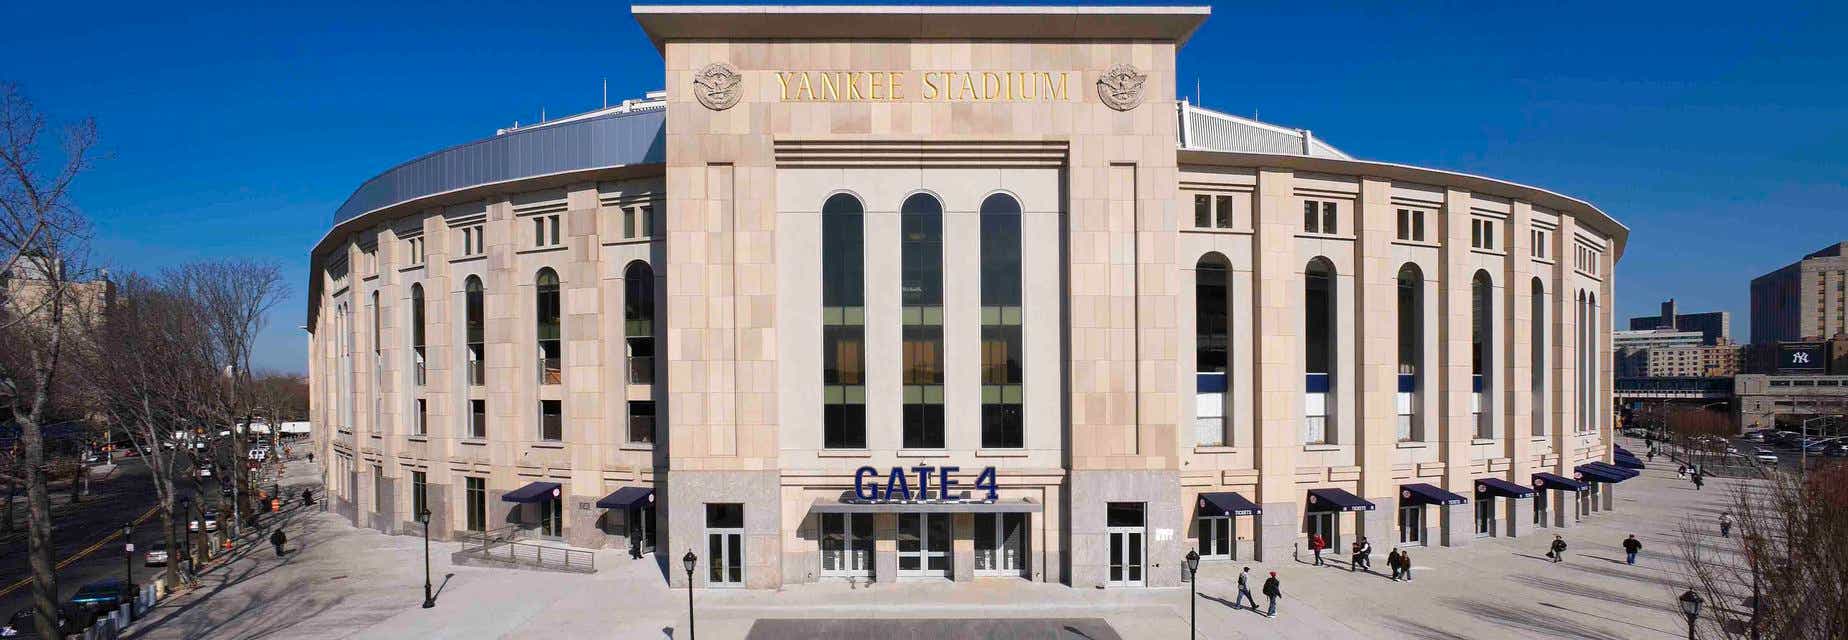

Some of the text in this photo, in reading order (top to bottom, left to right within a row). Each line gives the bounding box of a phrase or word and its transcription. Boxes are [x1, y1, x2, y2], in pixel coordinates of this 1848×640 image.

[776, 71, 1069, 101] YANKEE STADIUM
[854, 466, 999, 500] GATE 4
